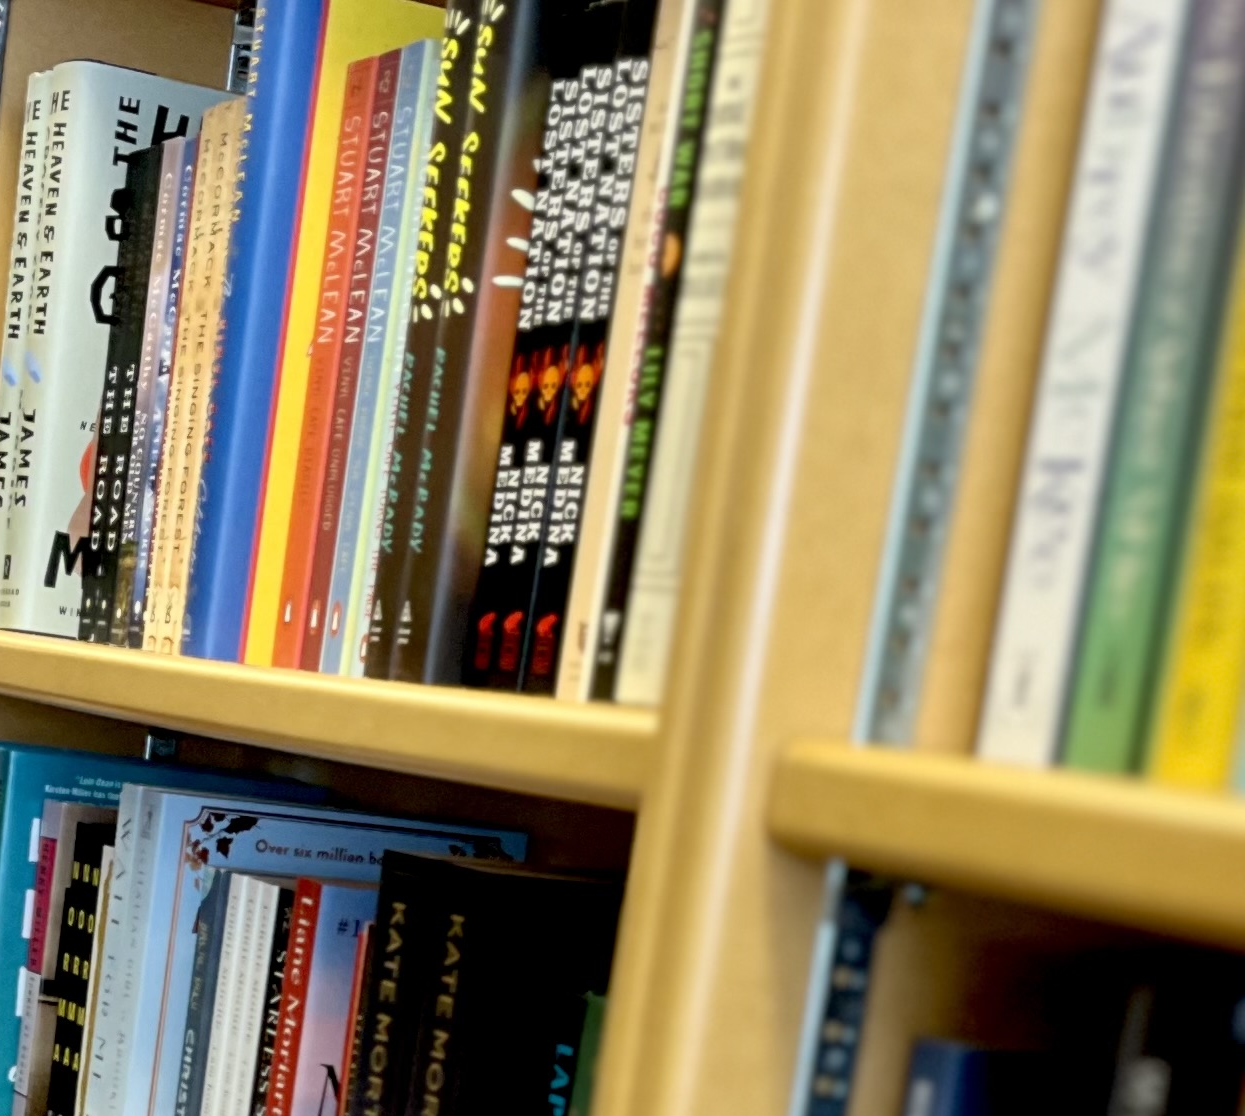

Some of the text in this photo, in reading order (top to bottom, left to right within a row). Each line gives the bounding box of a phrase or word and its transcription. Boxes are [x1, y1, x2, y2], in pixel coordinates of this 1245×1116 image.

[113, 96, 141, 166] THE
[361, 111, 389, 215] STUART
[7, 131, 38, 339] HEAVEN & EARTH
[33, 122, 67, 335] HEAVEN & EARTH
[157, 172, 173, 262] Cormac
[174, 165, 193, 257] Cormac
[317, 115, 362, 343] STUART McLEAN
[367, 106, 412, 342] STUART McLEAN
[413, 142, 446, 299] SEEKERS
[444, 131, 479, 294] SEEKERS
[518, 81, 565, 330] LOST NATION
[534, 80, 578, 326] SISTERS OF THE
[546, 67, 597, 323] LOST NATION
[564, 68, 612, 319] SISTERS OF THE
[580, 60, 632, 320] LOST NATION
[598, 60, 649, 316] SISTERS OF THE
[140, 276, 161, 391] McCarthy
[180, 315, 190, 356] THE
[196, 313, 207, 352] THE
[344, 229, 373, 343] McLEAN
[168, 366, 184, 457] SINGING
[185, 363, 202, 456] SINGING
[395, 351, 415, 434] RACHEL
[426, 347, 446, 431] RACHEL
[13, 409, 36, 507] JAMES
[91, 364, 118, 551] THE ROAD
[107, 363, 135, 551] THE ROAD
[173, 466, 189, 552] FOREST
[484, 446, 513, 566] MEDINA
[500, 470, 521, 543] NICK
[510, 440, 541, 564] MEDINA
[527, 466, 550, 541] NICK
[543, 441, 575, 566] MEDINA
[560, 466, 585, 542] NICK
[620, 418, 651, 518] MEYER
[157, 467, 173, 552] FOREST
[255, 838, 365, 864] Over six million
[290, 897, 314, 985] Liane
[379, 902, 406, 1002] KATE
[436, 914, 465, 1019] KATE
